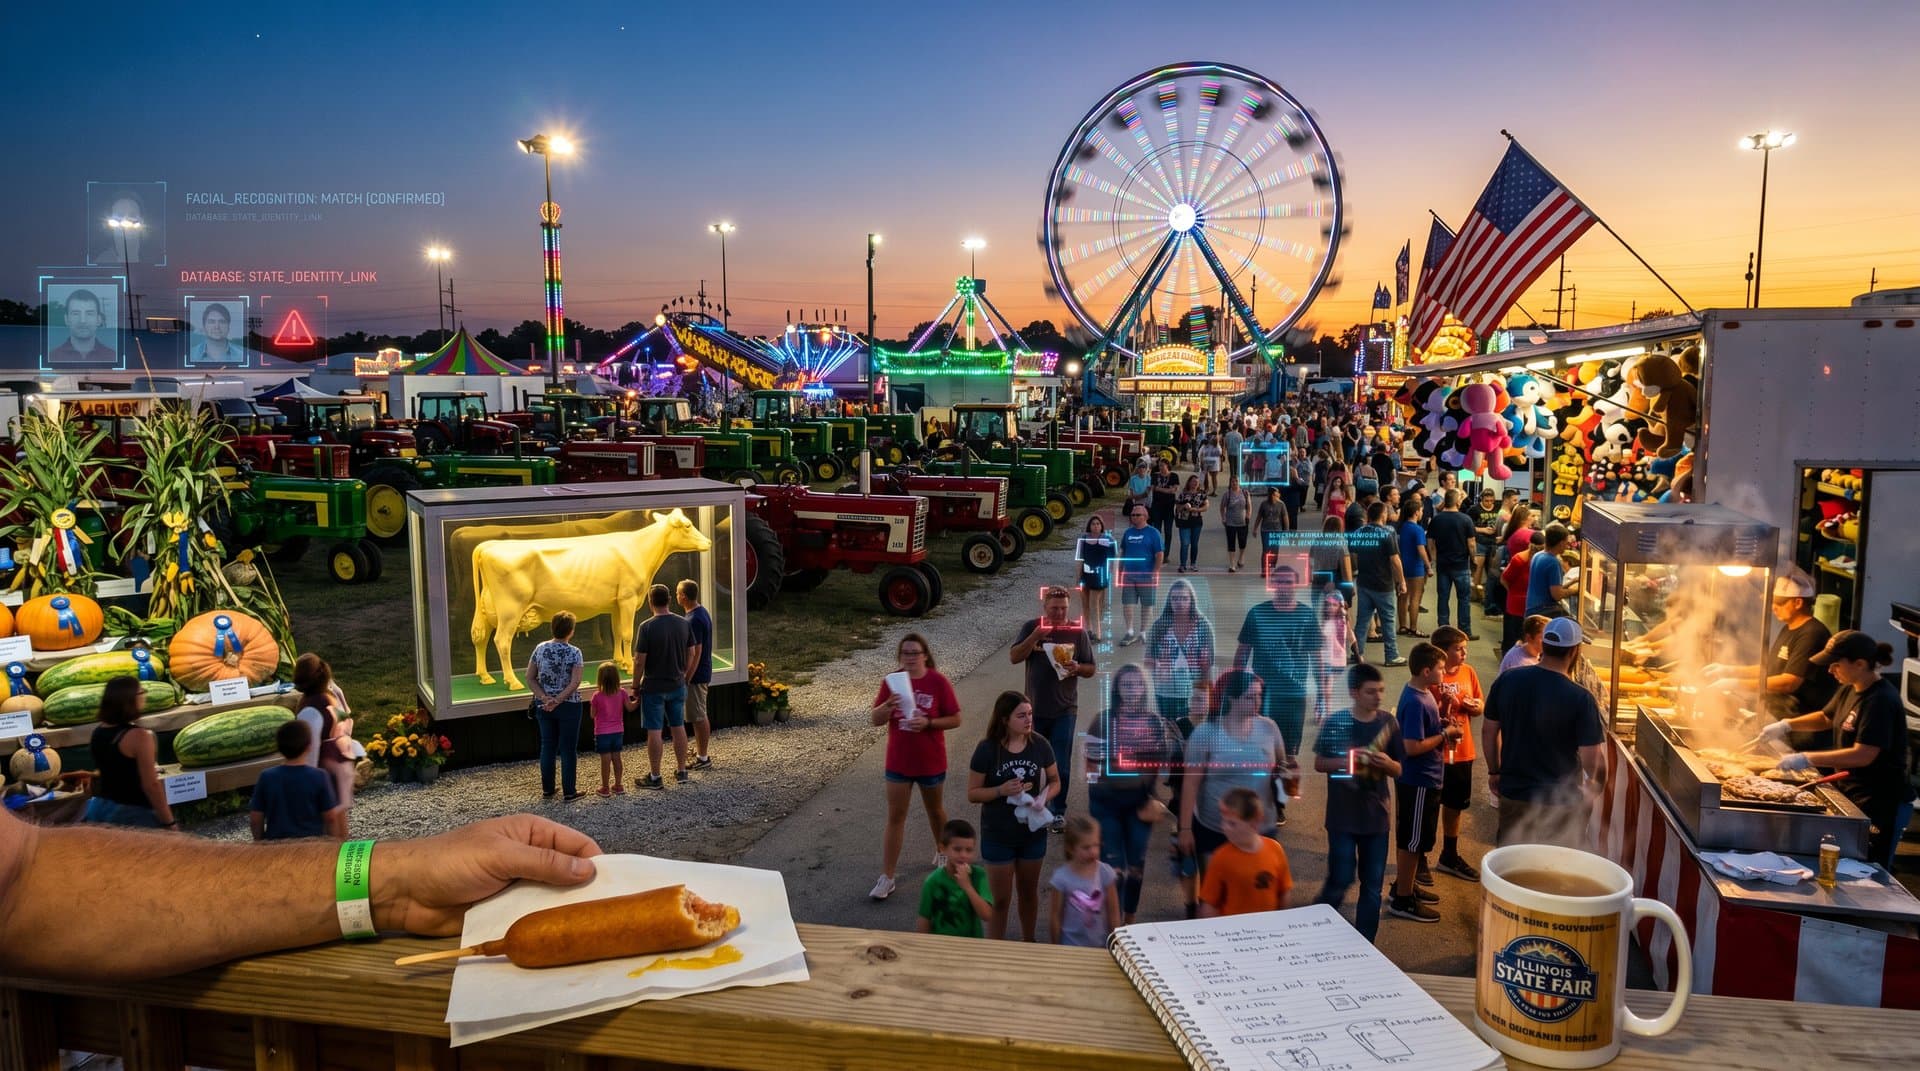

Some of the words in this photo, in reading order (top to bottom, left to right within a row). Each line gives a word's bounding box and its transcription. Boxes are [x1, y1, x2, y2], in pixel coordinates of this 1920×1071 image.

[1496, 963, 1547, 990] STATE
[1551, 978, 1593, 996] FAIR
[1516, 958, 1573, 978] ILLINOIS
